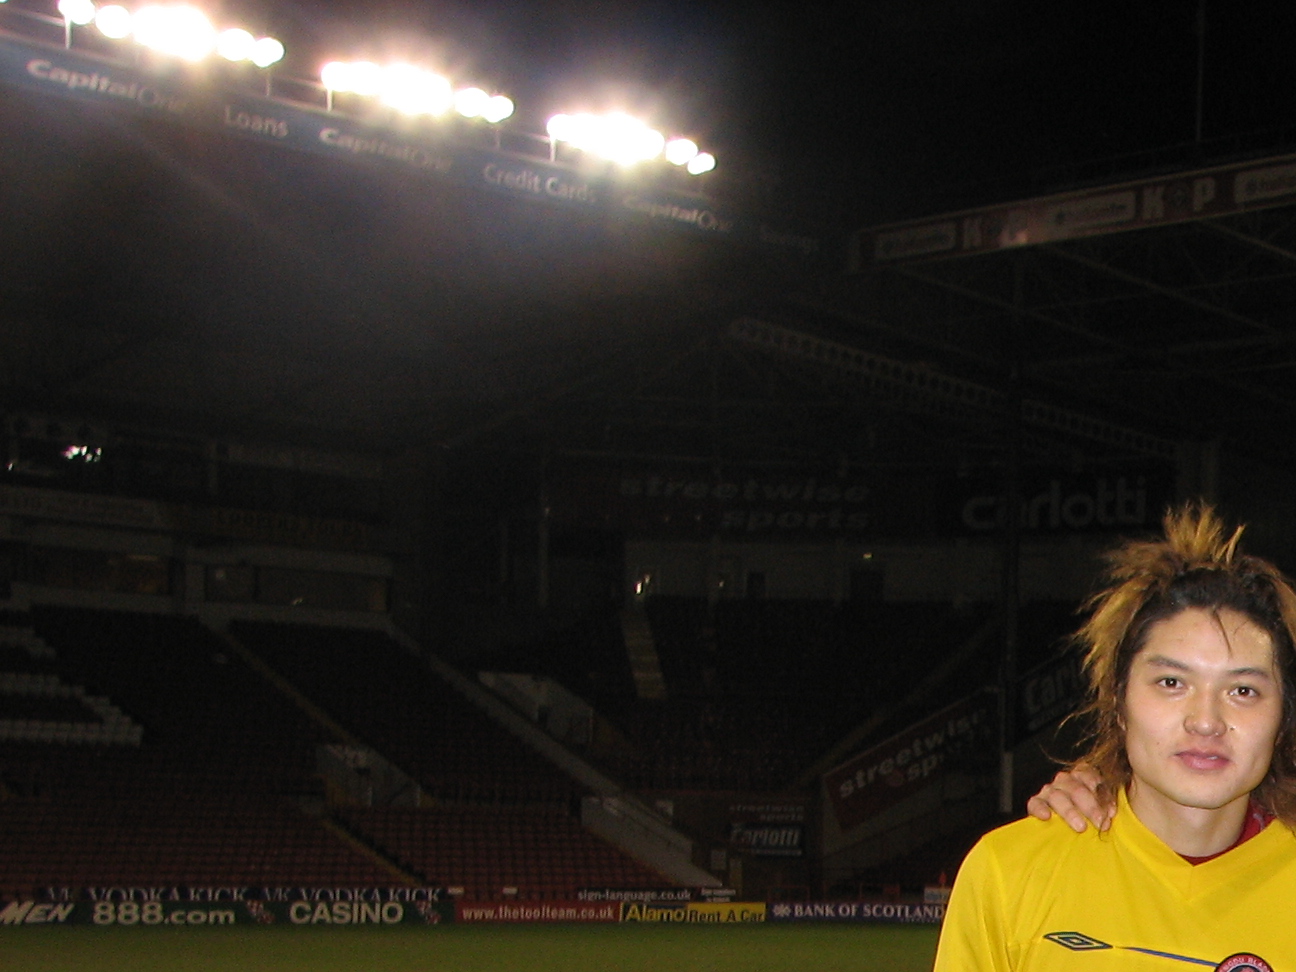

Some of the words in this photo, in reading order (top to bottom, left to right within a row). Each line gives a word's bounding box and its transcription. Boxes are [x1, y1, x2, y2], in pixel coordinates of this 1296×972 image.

[224, 104, 289, 139] Loans
[483, 164, 541, 193] Credit
[92, 901, 236, 925] 888.com
[289, 901, 405, 925] CASINO
[626, 901, 687, 922] Alamo
[688, 910, 721, 922] Rent
[726, 910, 738, 922] A
[741, 910, 766, 922] Car
[794, 904, 836, 919] BANK
[838, 905, 858, 918] OF
[862, 904, 944, 920] SCOTLAND
